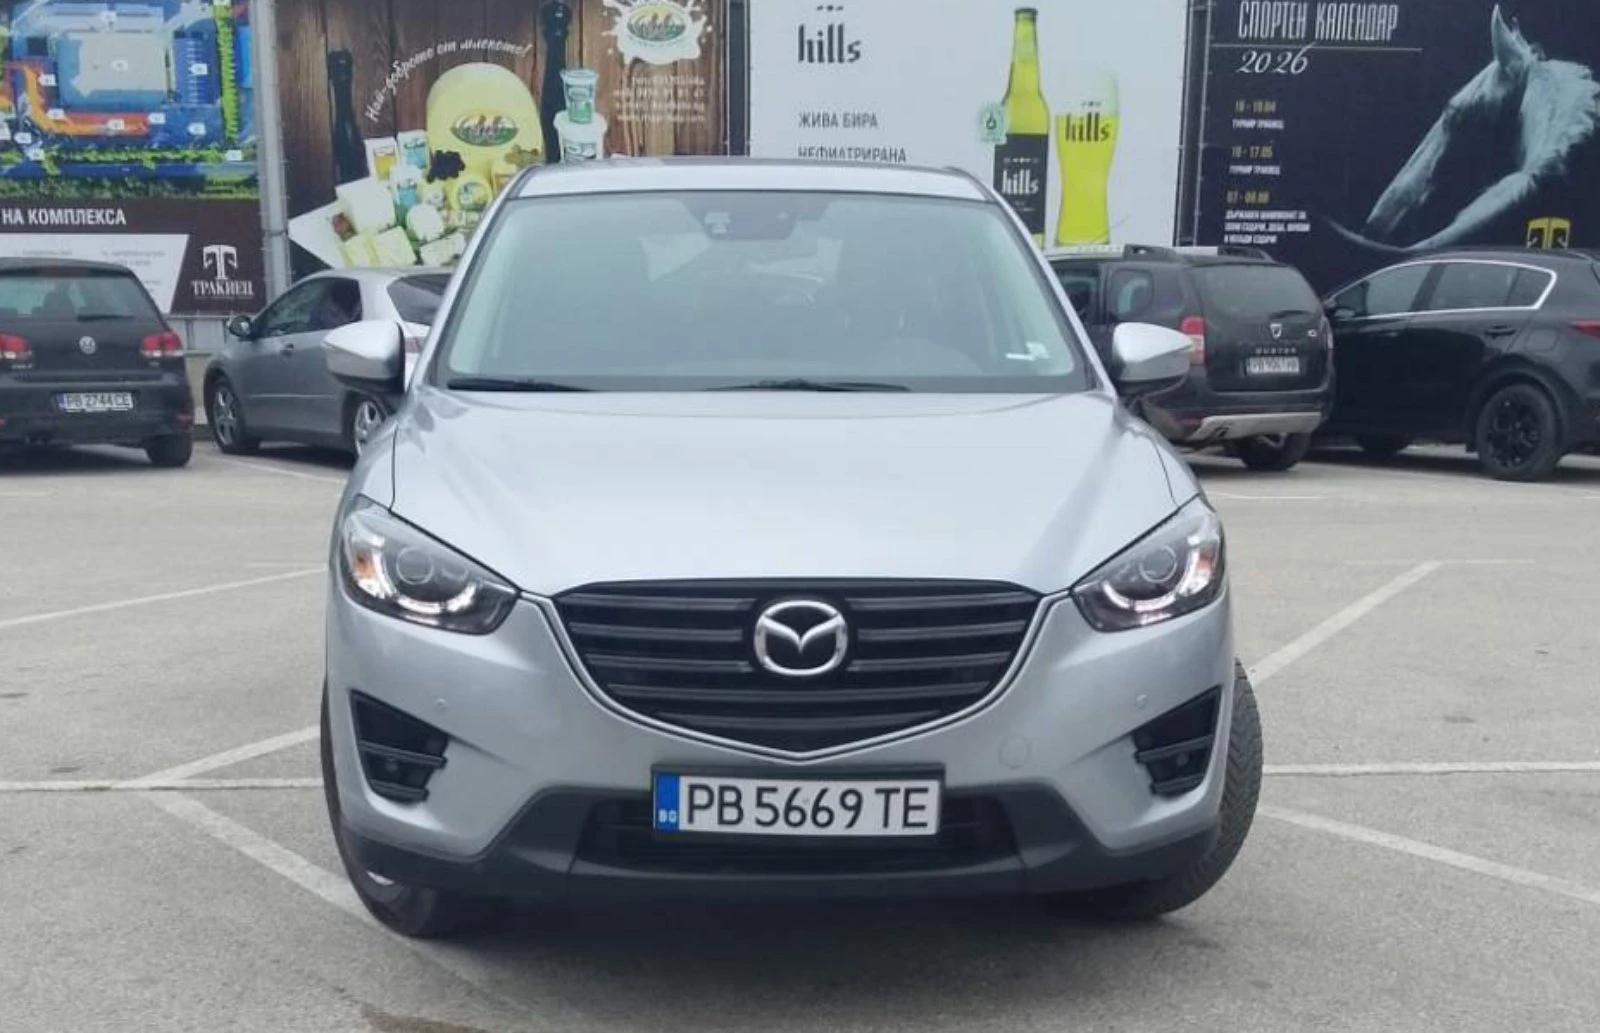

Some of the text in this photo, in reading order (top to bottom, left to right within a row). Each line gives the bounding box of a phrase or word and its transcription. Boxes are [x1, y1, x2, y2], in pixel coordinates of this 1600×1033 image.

[1238, 0, 1399, 41] СПОРТЕН КАЛЕНДАР
[437, 40, 456, 54] от
[798, 22, 862, 64] hills
[1236, 41, 1317, 74] 2026
[799, 111, 878, 128] ЖИВА БИРА
[1064, 111, 1111, 143] hills
[798, 146, 907, 163] НЕФИЛТРИРАНА
[1001, 169, 1040, 196] hills
[2, 208, 127, 226] НА КОМПЛЕКСА
[191, 280, 254, 296] ТРАКИЕЦ
[658, 810, 677, 823] BG
[687, 784, 929, 829] PB 5669 TE
